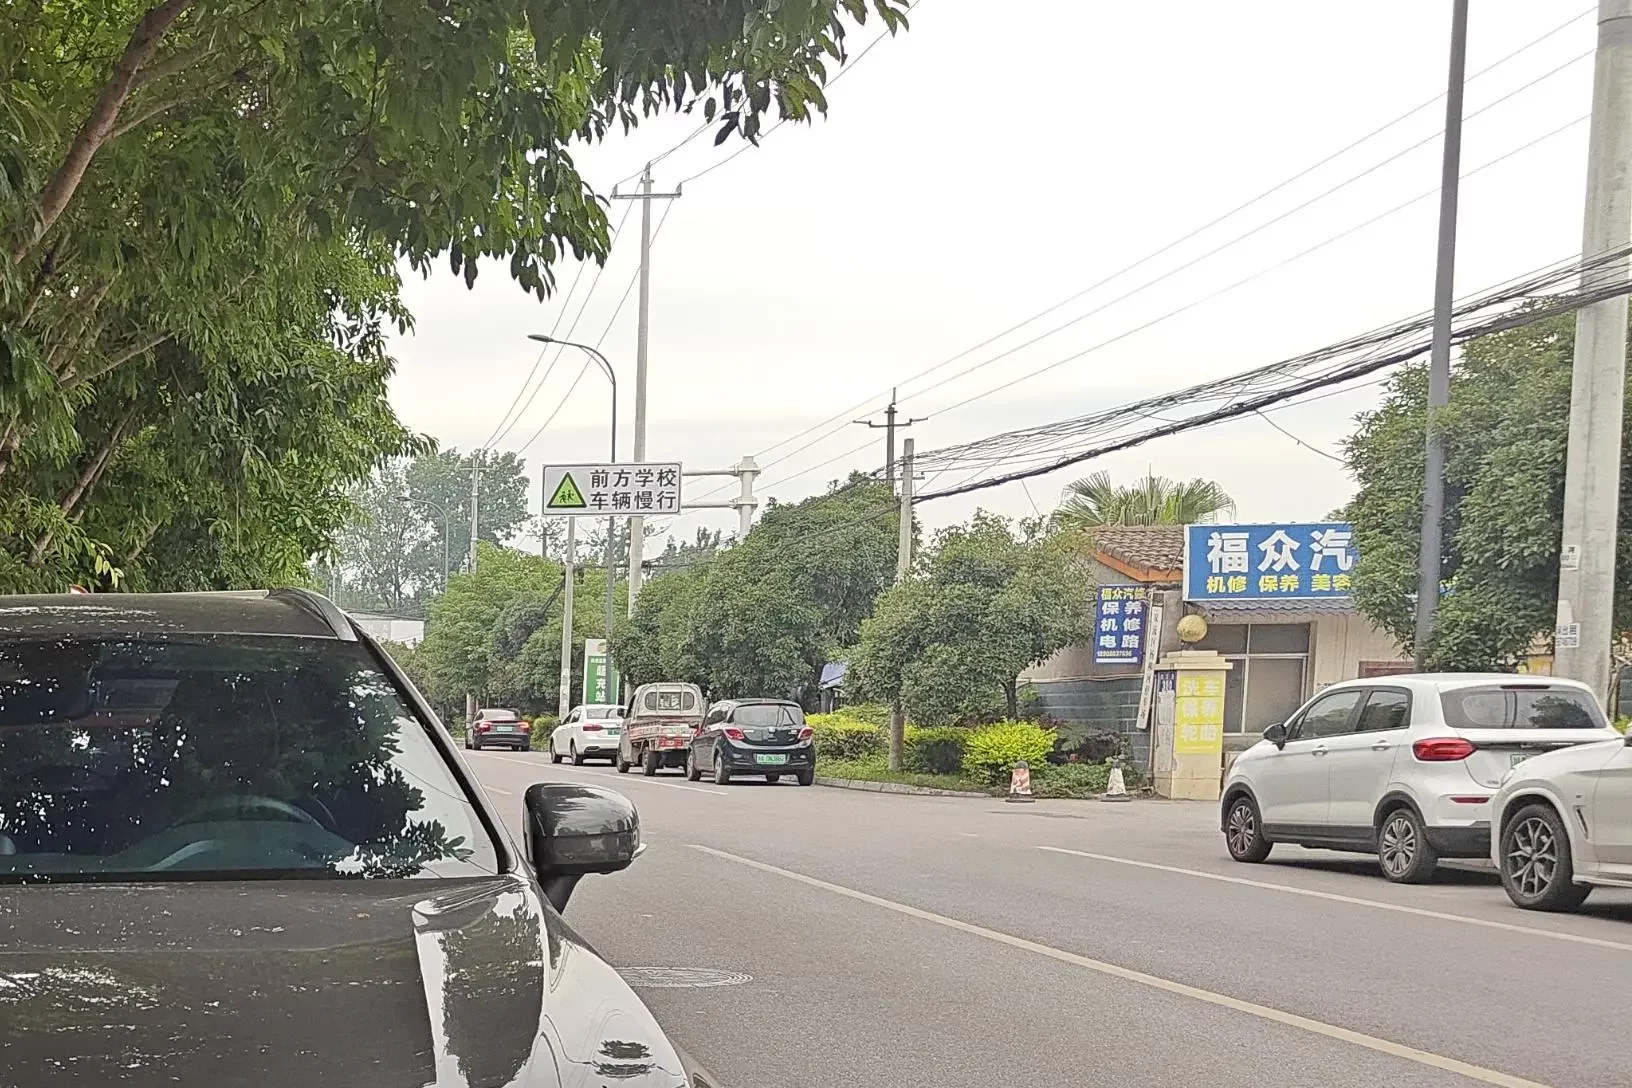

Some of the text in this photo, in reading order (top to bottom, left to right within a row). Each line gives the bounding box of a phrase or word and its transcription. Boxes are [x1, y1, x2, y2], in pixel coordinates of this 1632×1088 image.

[590, 469, 677, 488] 前方学校
[589, 491, 677, 510] 车辆慢行
[1207, 530, 1353, 573] 福众汽
[1206, 576, 1247, 594] 机修
[1258, 574, 1299, 592] 保养
[1101, 601, 1142, 615] 保养
[1100, 618, 1141, 632] 机修
[1099, 635, 1139, 648] 电路
